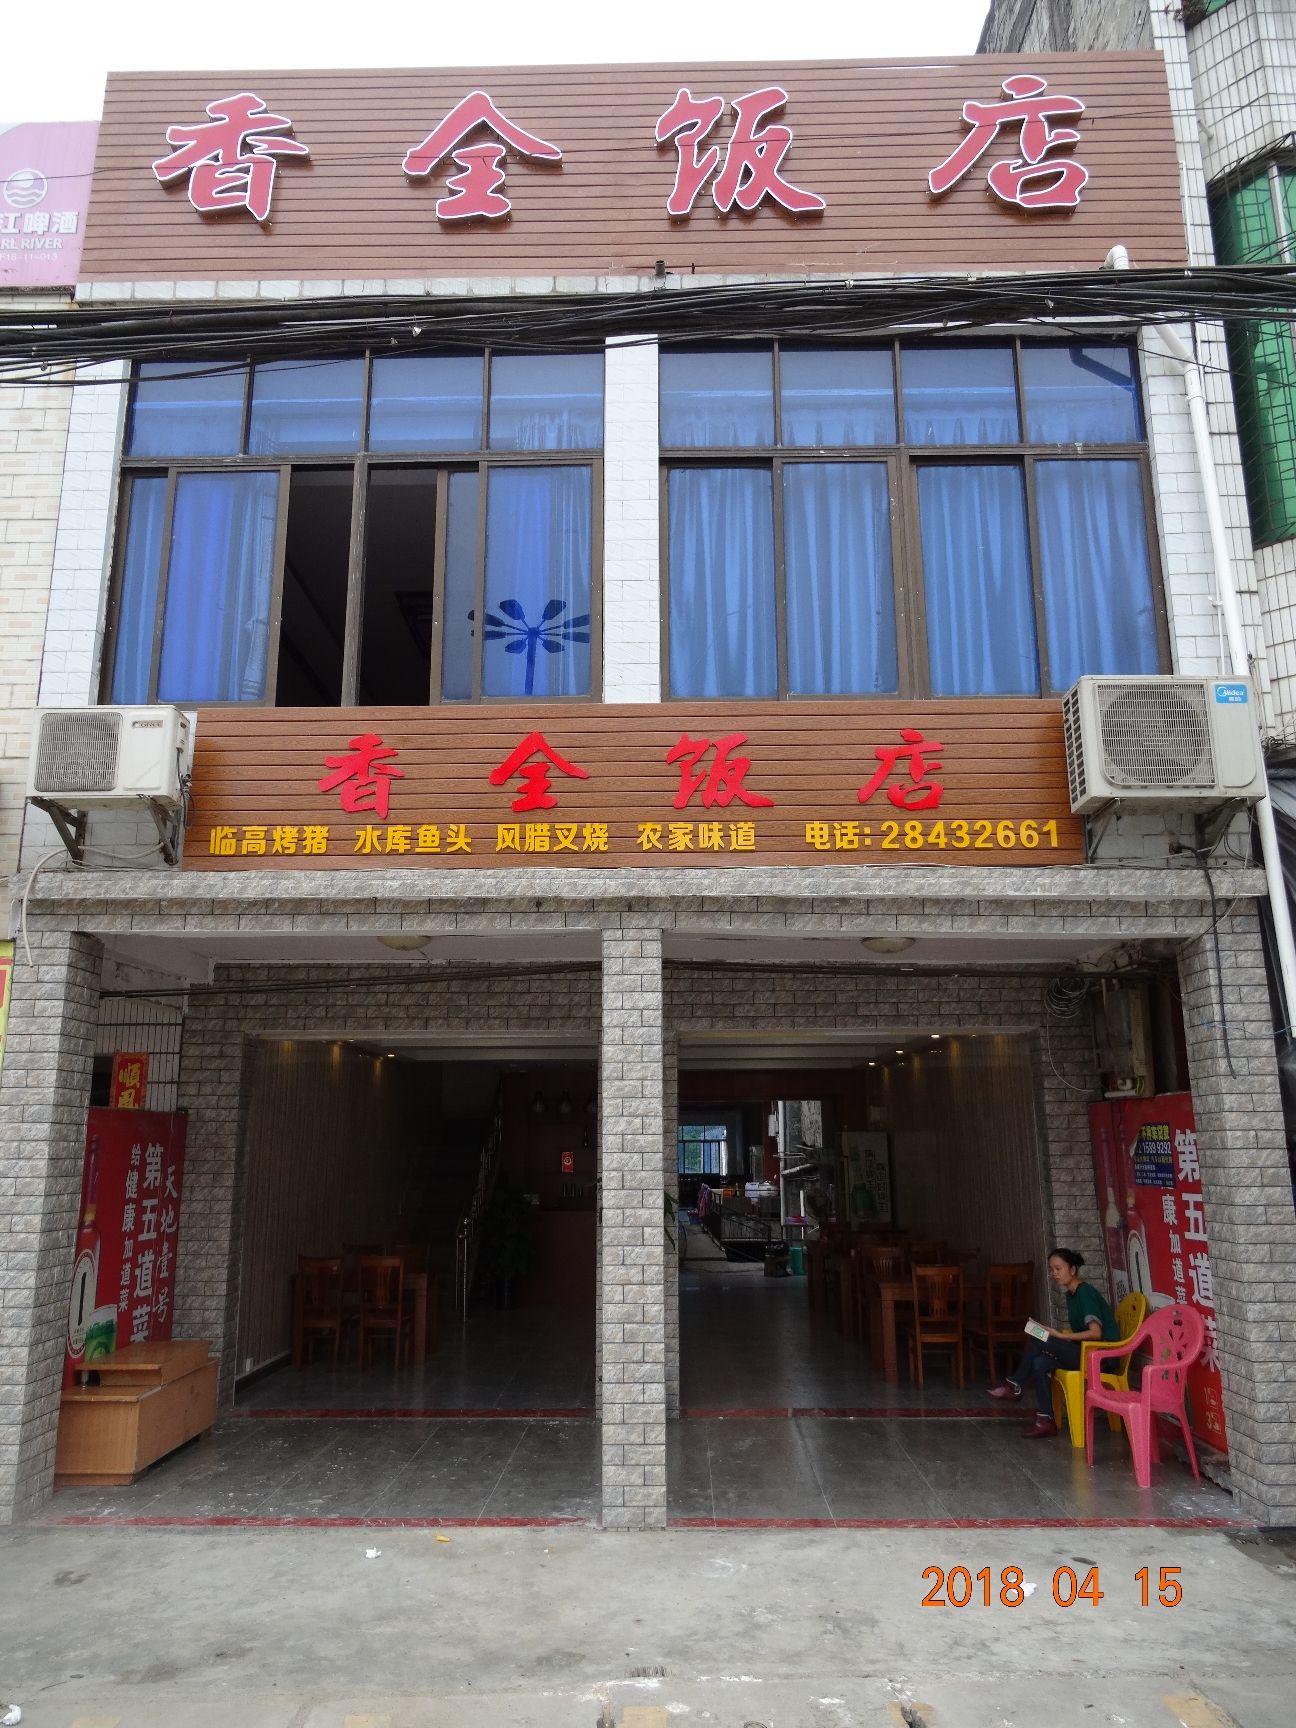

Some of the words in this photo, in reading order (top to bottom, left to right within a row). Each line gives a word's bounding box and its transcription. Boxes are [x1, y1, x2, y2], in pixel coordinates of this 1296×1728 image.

[152, 75, 1089, 221] 香全饭店
[21, 237, 63, 250] RIVER
[209, 826, 329, 855] 临高烤猪
[355, 824, 472, 854] 水库鱼头
[496, 823, 609, 852] 风腊叉烧
[637, 822, 756, 851] 农家味道
[318, 729, 944, 820] 香全饭店
[118, 1144, 142, 1313] 给健康加道菜
[130, 1142, 164, 1344] 第五道菜
[152, 1165, 179, 1323] 天地壹号
[1161, 1187, 1188, 1305] 康加道菜
[1174, 1128, 1220, 1373] 第五道菜
